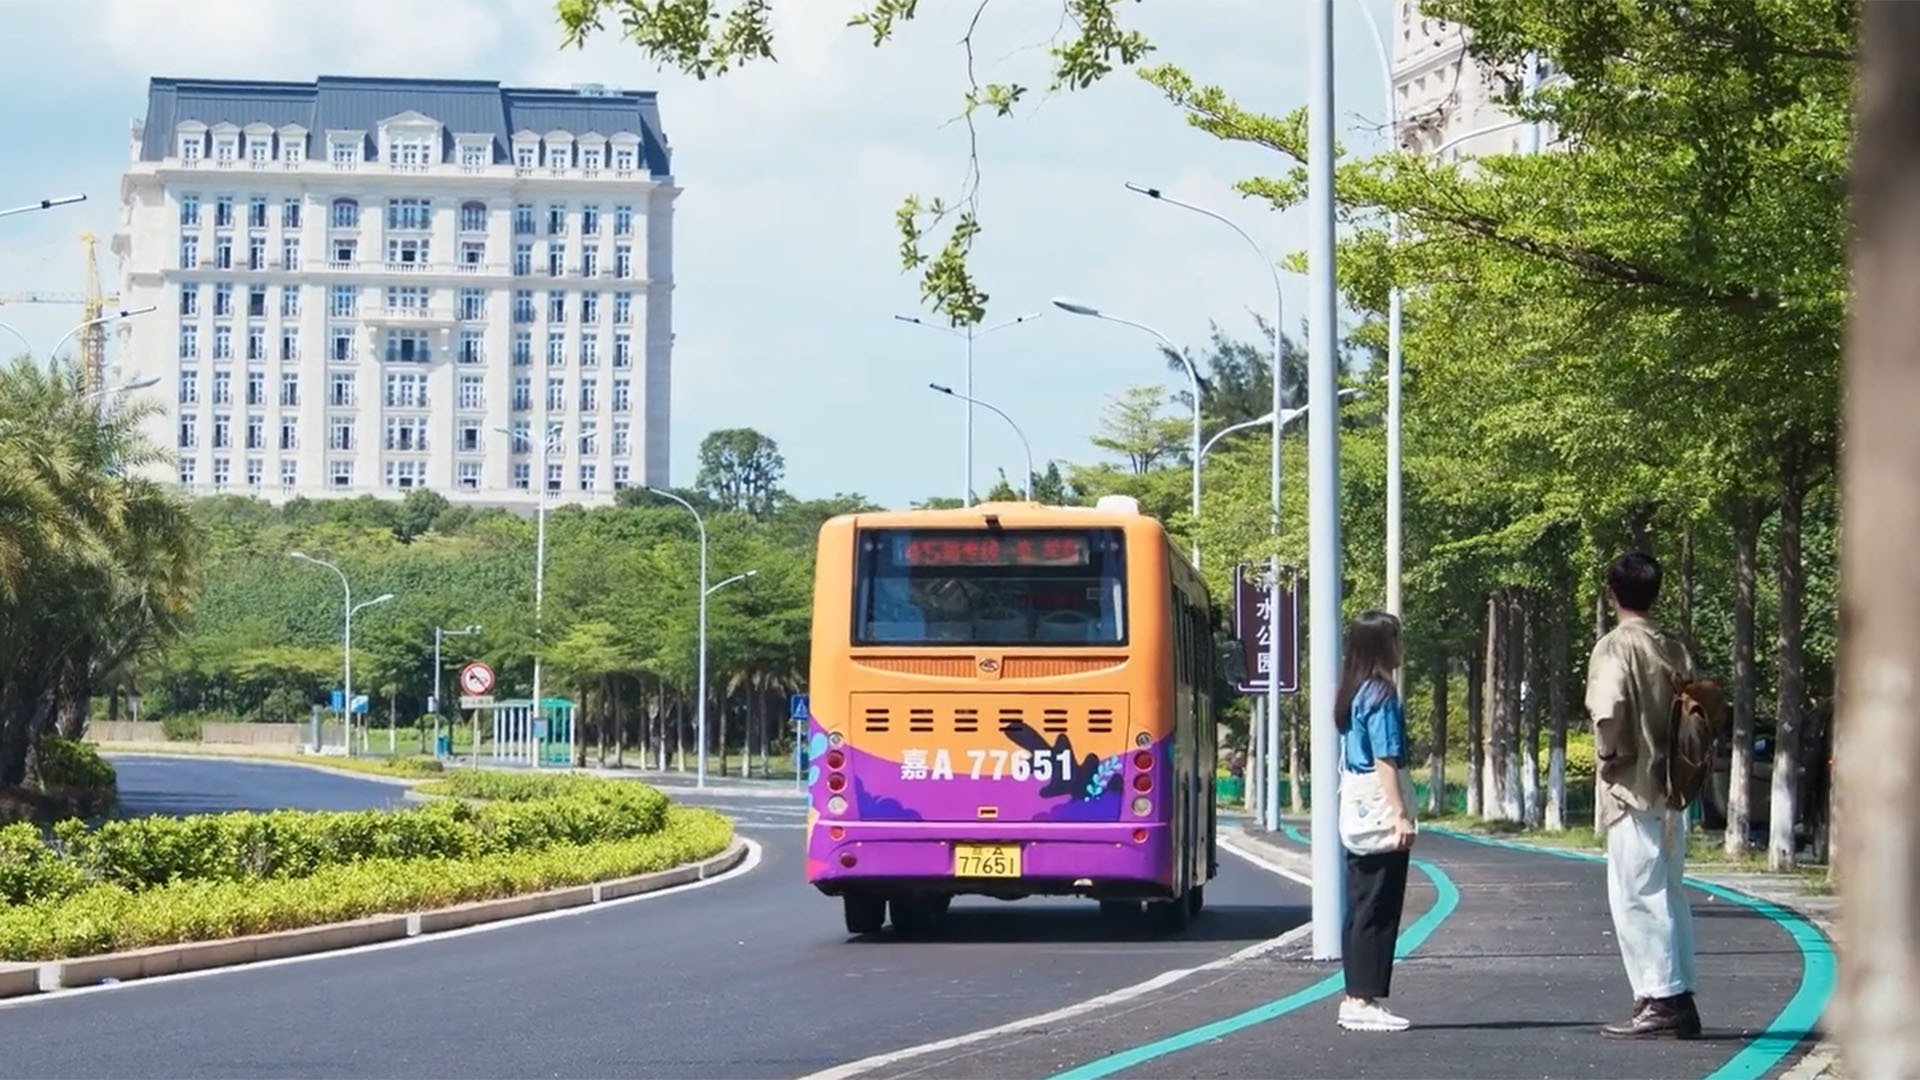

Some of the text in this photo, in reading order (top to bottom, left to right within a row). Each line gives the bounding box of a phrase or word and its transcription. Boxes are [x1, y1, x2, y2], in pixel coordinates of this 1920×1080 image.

[900, 749, 1072, 782] 嘉A 77651
[959, 856, 1015, 875] 77651
